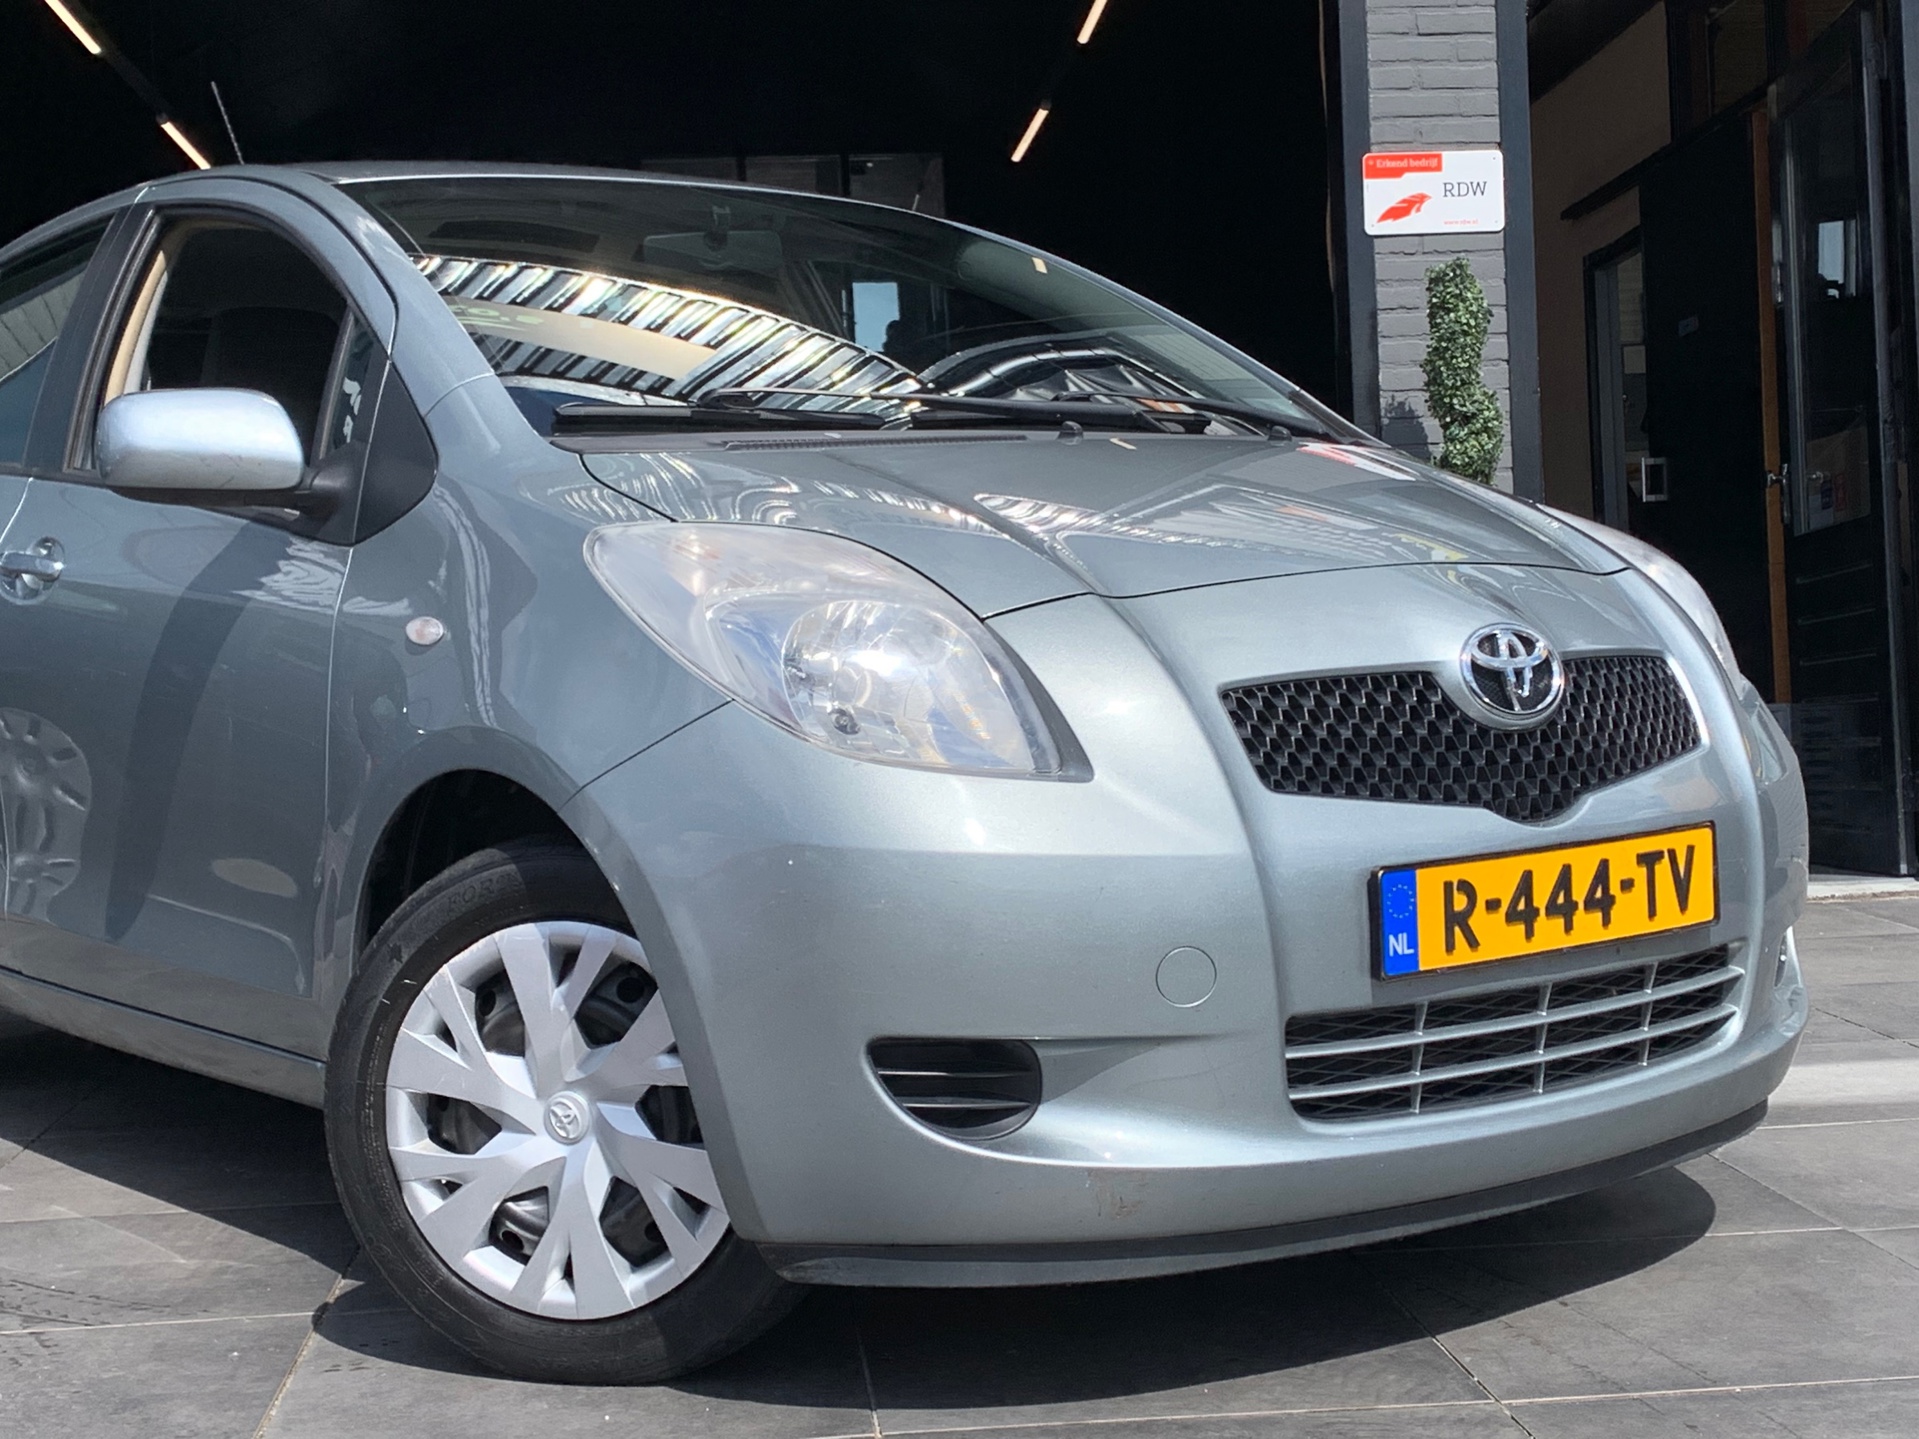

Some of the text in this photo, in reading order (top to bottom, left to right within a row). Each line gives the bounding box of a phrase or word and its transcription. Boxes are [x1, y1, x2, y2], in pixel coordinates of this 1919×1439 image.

[1376, 157, 1438, 168] Erkend bedrijf
[1443, 181, 1487, 198] RDW
[1443, 845, 1695, 955] R-444-TV
[1388, 933, 1414, 957] NL
